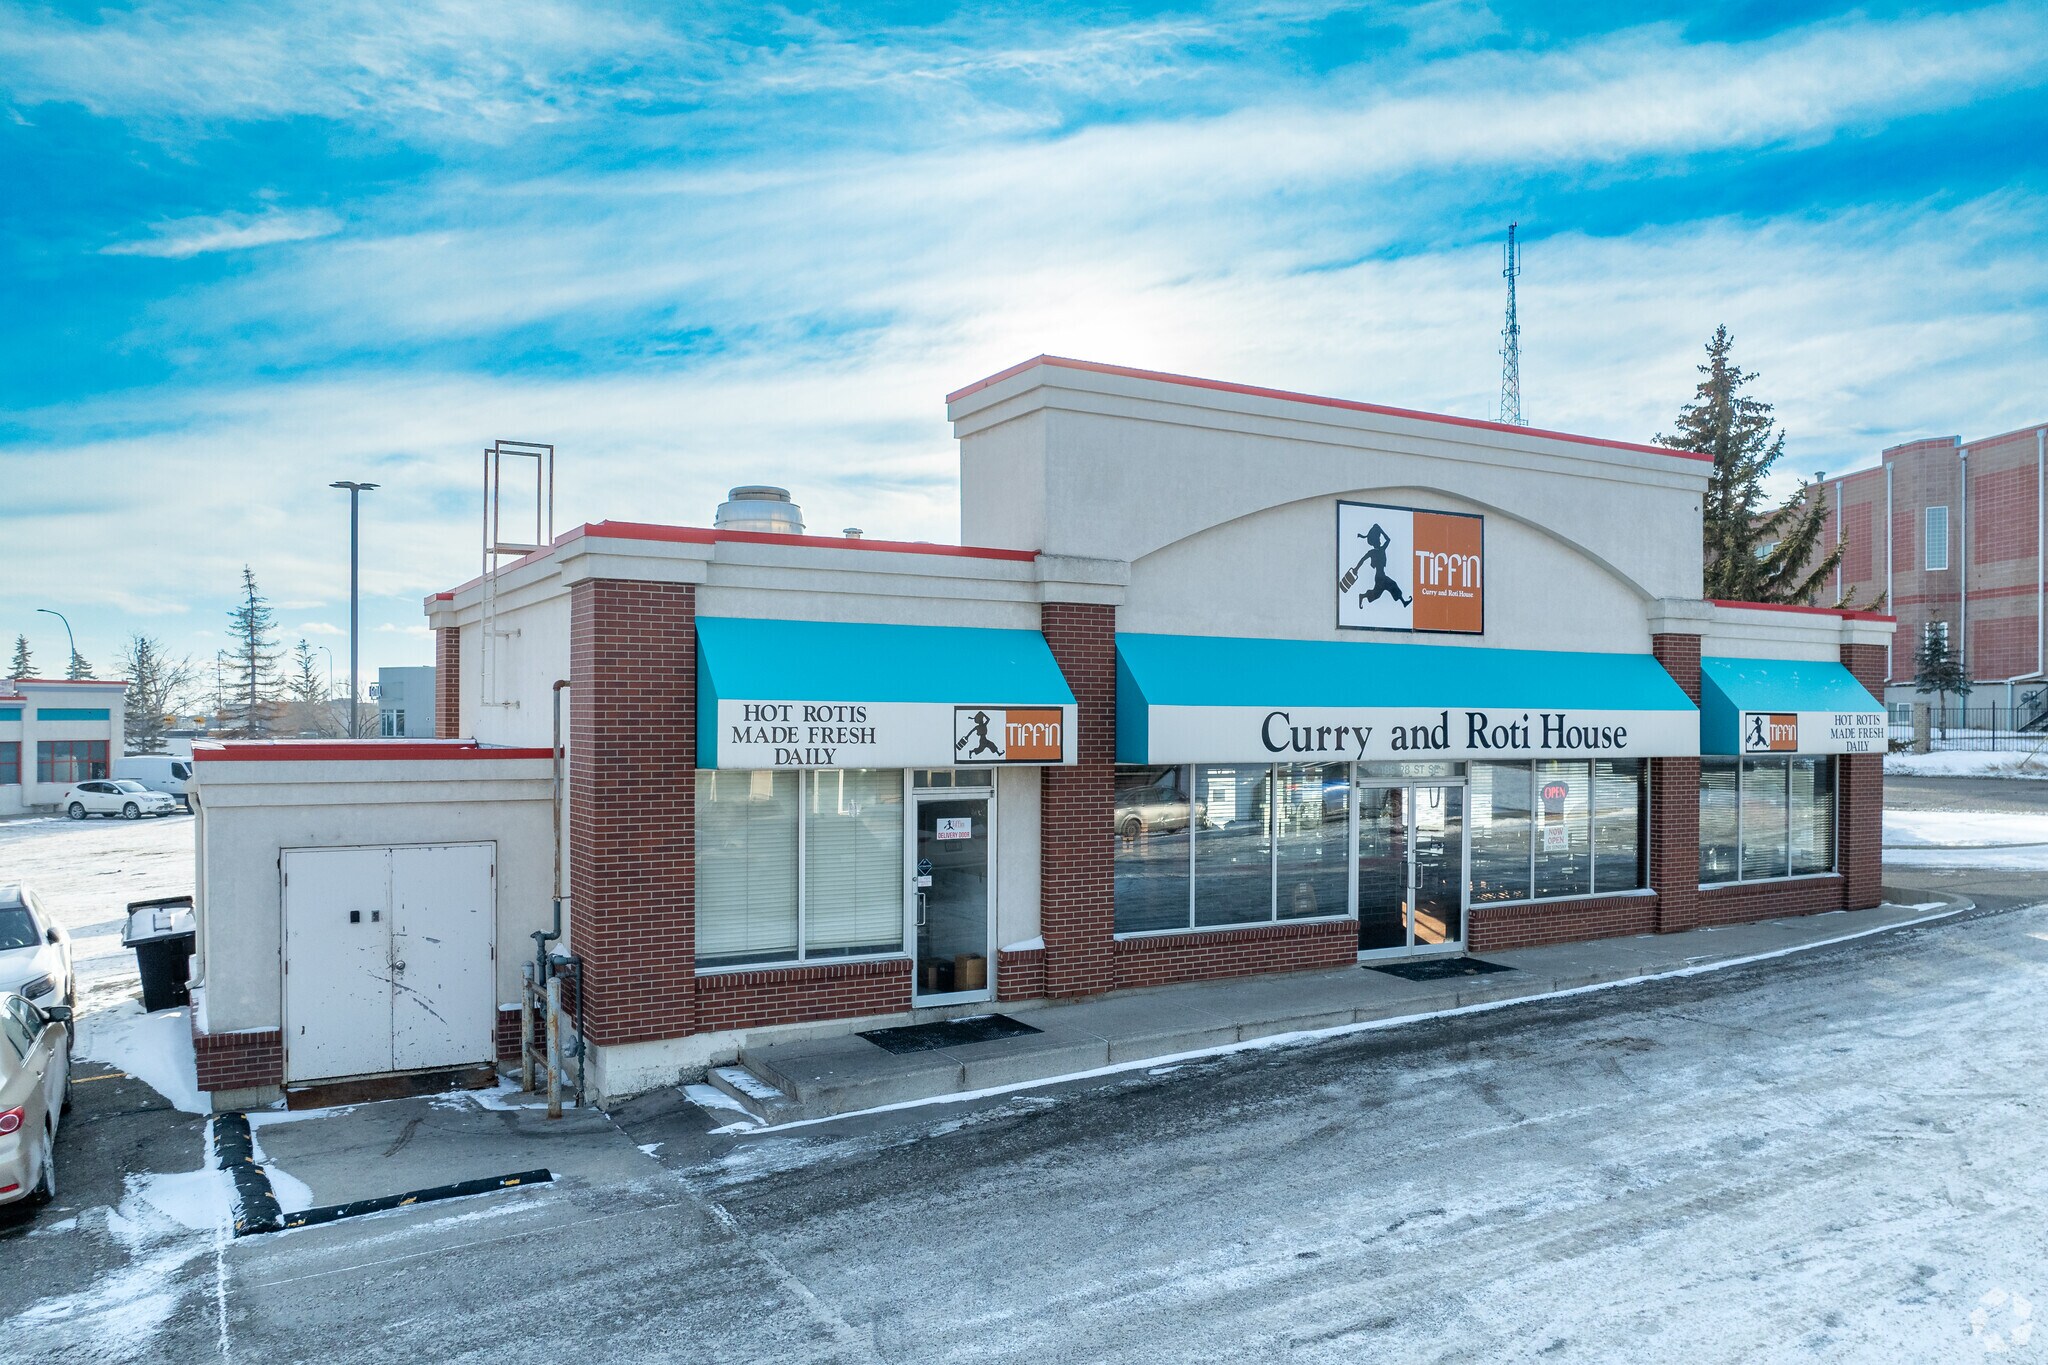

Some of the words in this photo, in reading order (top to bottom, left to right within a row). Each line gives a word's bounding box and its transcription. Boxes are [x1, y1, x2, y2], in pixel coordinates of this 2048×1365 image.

[1415, 550, 1481, 588] Tiffin
[1422, 588, 1438, 596] Curry
[1448, 589, 1459, 597] Roti
[1459, 590, 1474, 598] House
[743, 704, 794, 722] HOT
[802, 705, 867, 723] ROTIS
[1834, 714, 1853, 726] HOT
[1856, 714, 1881, 726] ROTIS
[731, 726, 800, 744] MADE
[807, 726, 877, 745] FRESH
[1006, 722, 1060, 747] Tiffin
[1261, 710, 1373, 760] Curry
[1390, 710, 1450, 751] and
[1464, 711, 1530, 750] Roti
[1539, 713, 1628, 750] House
[1830, 727, 1856, 739] MADE
[1858, 727, 1884, 739] FRESH
[1846, 740, 1869, 752] DAILY
[774, 747, 837, 765] DAILY
[1413, 764, 1425, 774] ST
[1544, 786, 1566, 799] OPEN
[1549, 827, 1563, 835] NOW
[1548, 836, 1564, 844] OPEN
